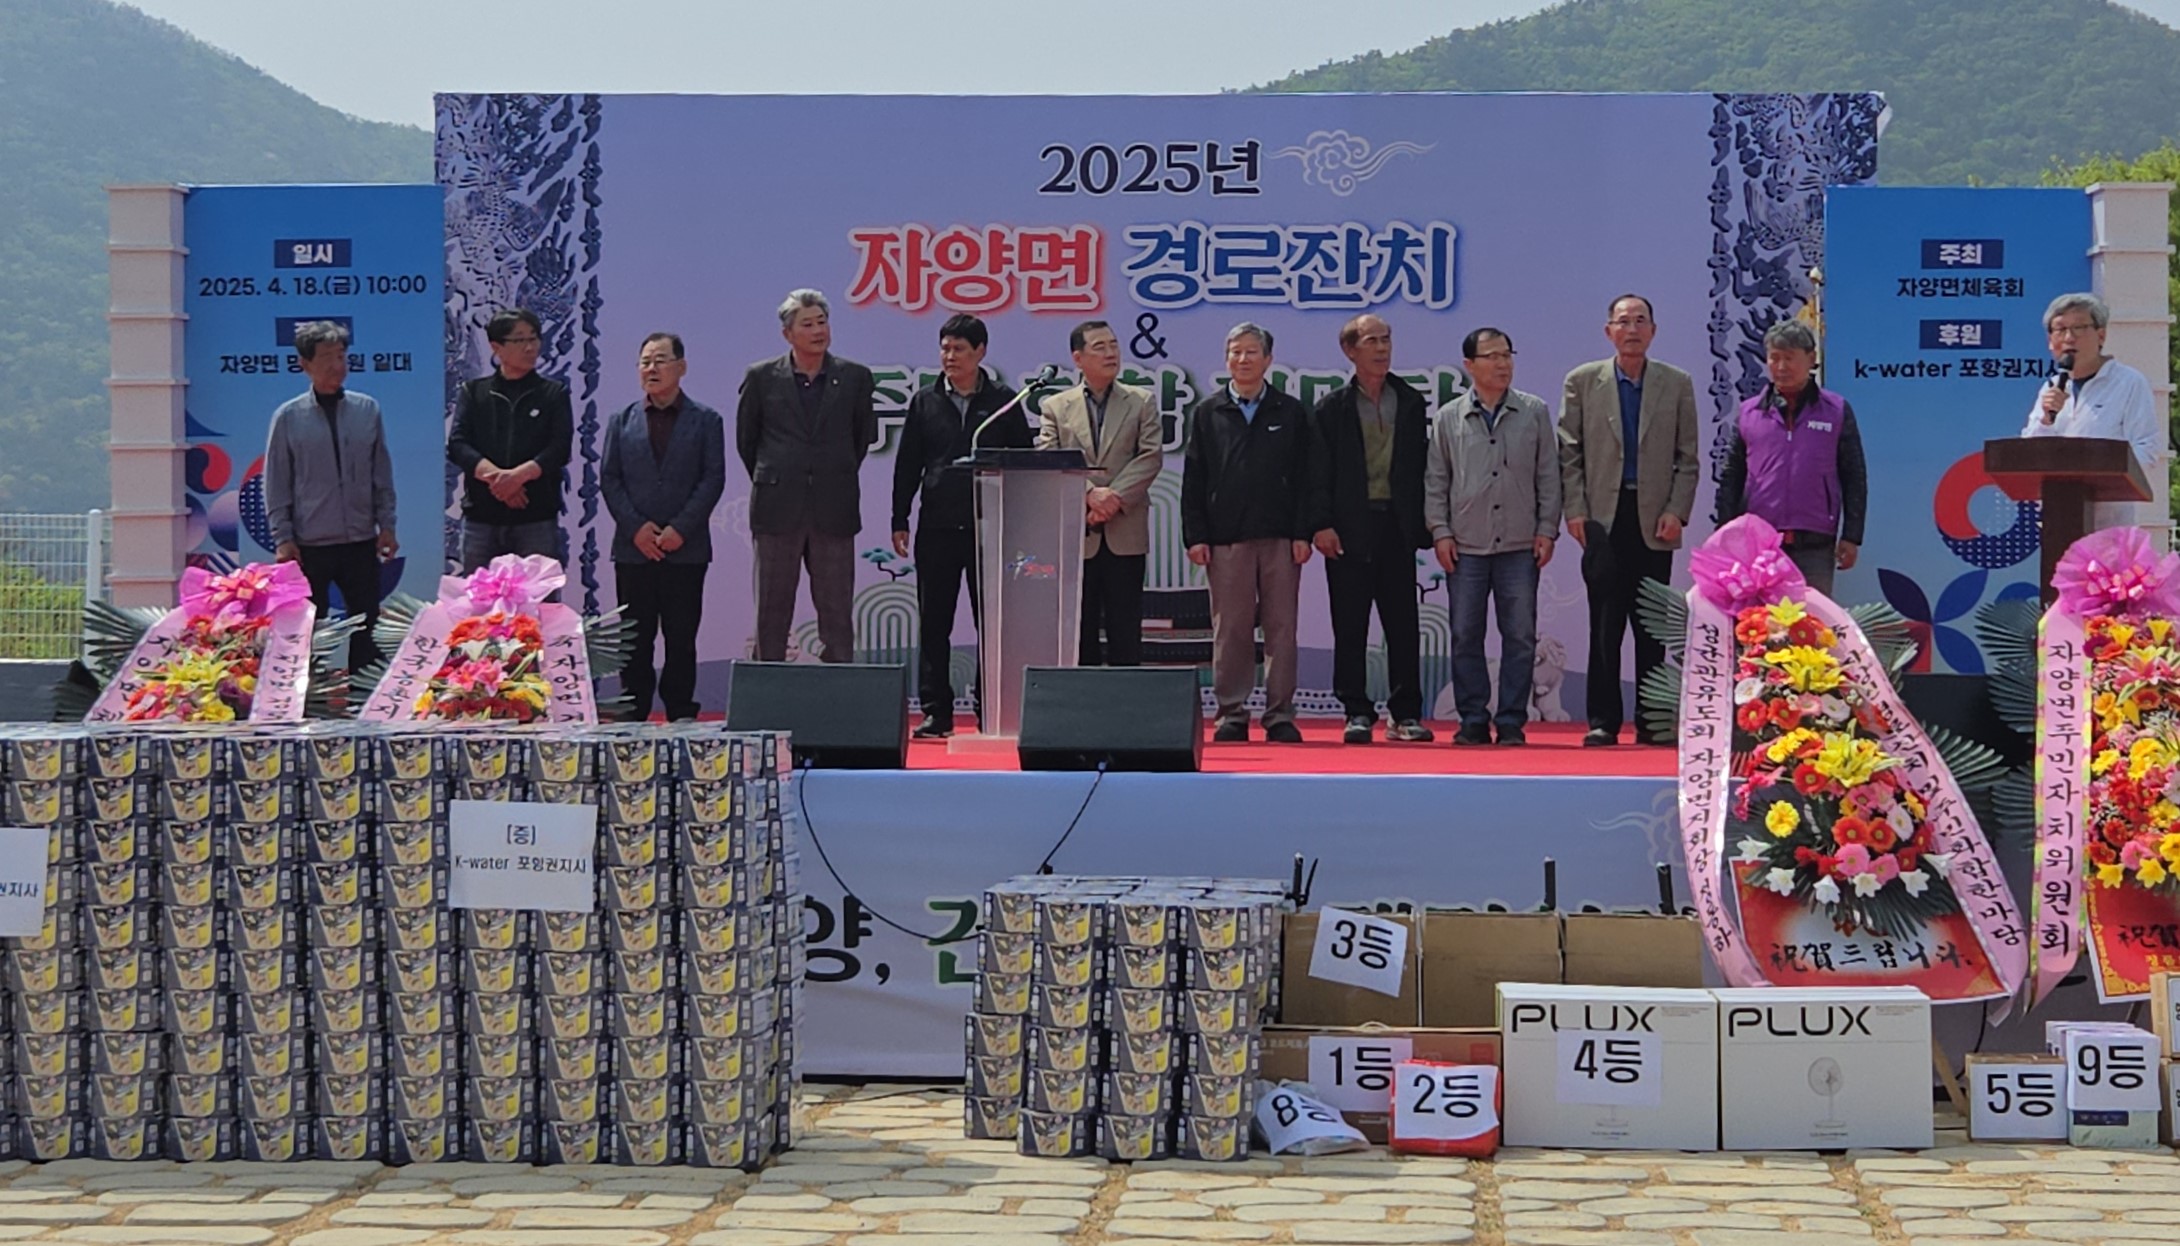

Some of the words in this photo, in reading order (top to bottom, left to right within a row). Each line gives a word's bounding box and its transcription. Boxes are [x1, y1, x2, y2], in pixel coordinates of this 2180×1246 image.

[1040, 140, 1261, 194] 2025년
[293, 243, 333, 264] 일시
[850, 227, 1100, 306] 자양면
[1125, 225, 1454, 306] 경로잔치
[1939, 243, 1982, 265] 주최
[199, 277, 261, 296] 2025.
[267, 277, 288, 296] 4.
[366, 275, 427, 294] 10:00
[1897, 277, 2024, 298] 자양면체육회
[1130, 312, 1168, 360] &
[1938, 323, 1982, 345] 후원
[219, 354, 279, 374] 자양면
[372, 352, 413, 372] 일대
[1855, 358, 1953, 378] k-water
[455, 855, 510, 870] K-water
[1330, 918, 1394, 970] 3등
[1512, 1004, 1656, 1033] PLUX
[1728, 1005, 1872, 1037] PLUX
[1329, 1046, 1394, 1091] 1등
[1573, 1038, 1643, 1084] 4등
[2077, 1044, 2146, 1090] 9등
[1413, 1073, 1482, 1119] 2등
[1987, 1072, 2056, 1117] 5등
